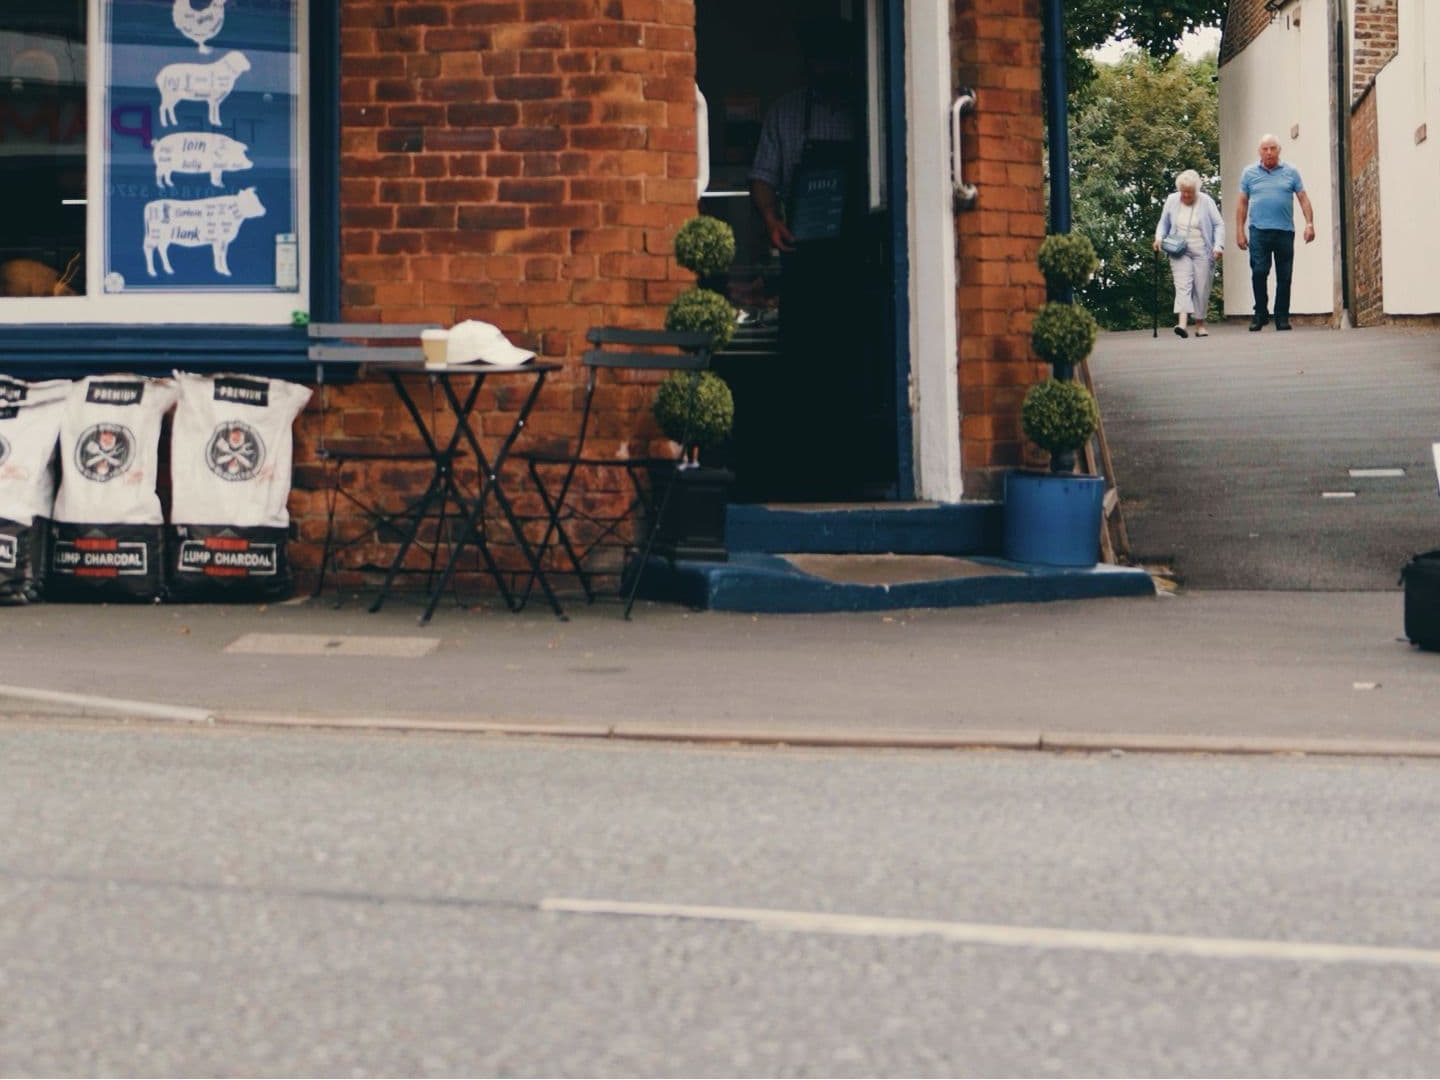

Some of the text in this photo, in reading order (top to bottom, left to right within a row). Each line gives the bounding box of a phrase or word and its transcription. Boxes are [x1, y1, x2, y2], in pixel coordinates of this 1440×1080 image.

[84, 552, 142, 566] CHARCOAL
[184, 550, 272, 566] LUMP CHARCOAL
